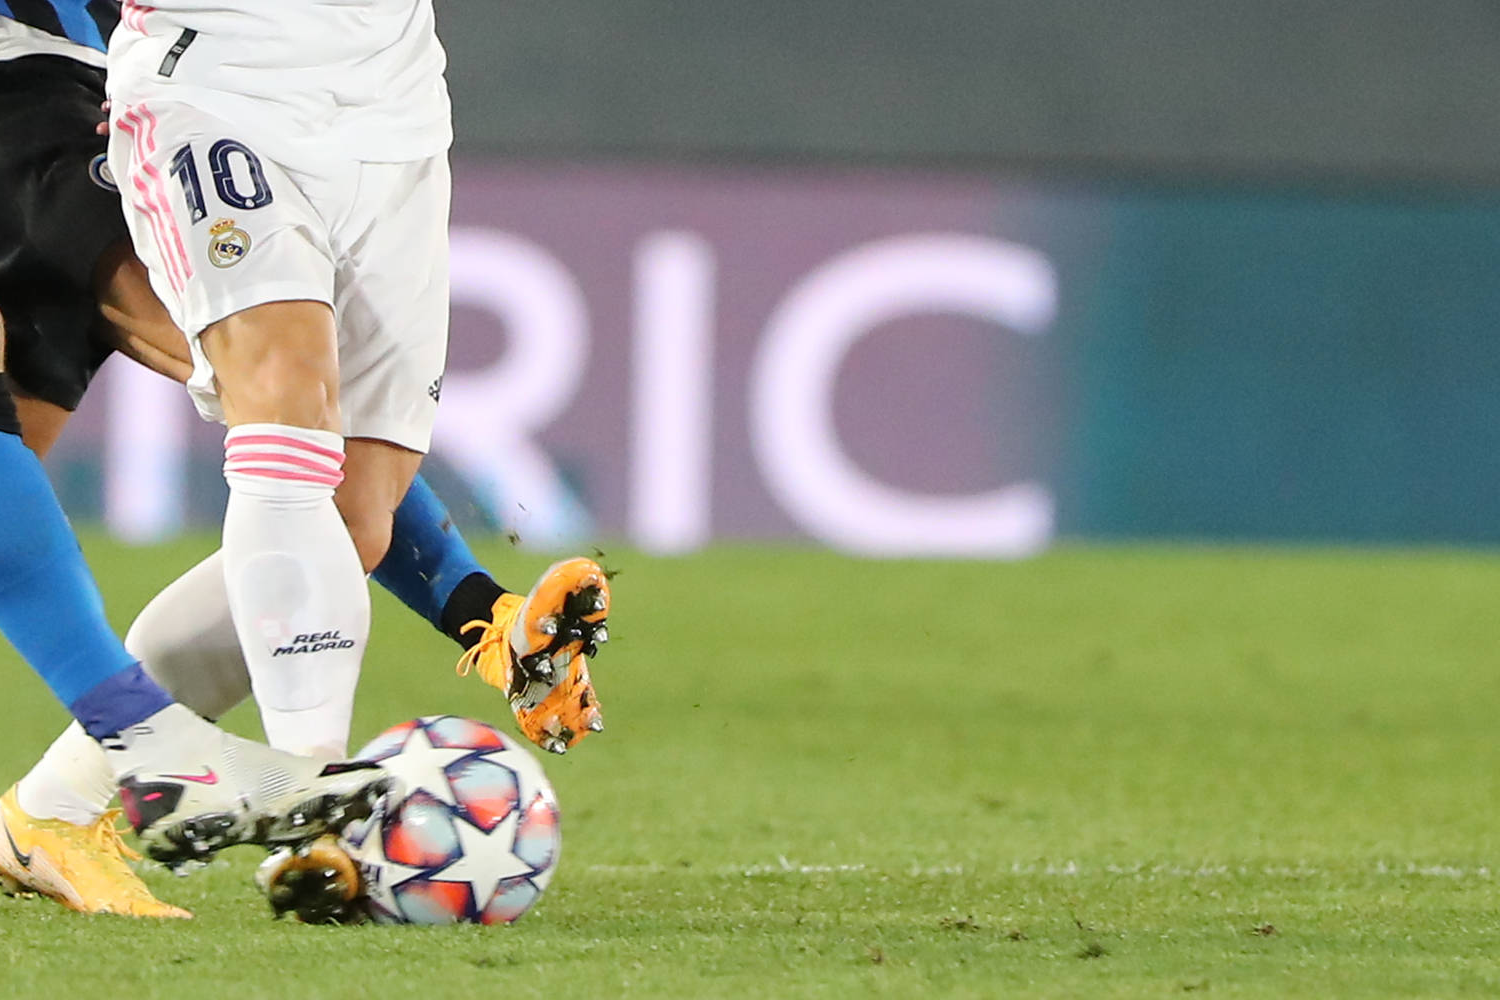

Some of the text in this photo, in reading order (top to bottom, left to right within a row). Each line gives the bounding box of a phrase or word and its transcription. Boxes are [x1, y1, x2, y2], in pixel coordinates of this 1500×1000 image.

[169, 138, 274, 225] 10
[293, 630, 342, 645] REAL
[272, 639, 355, 657] MADRID
